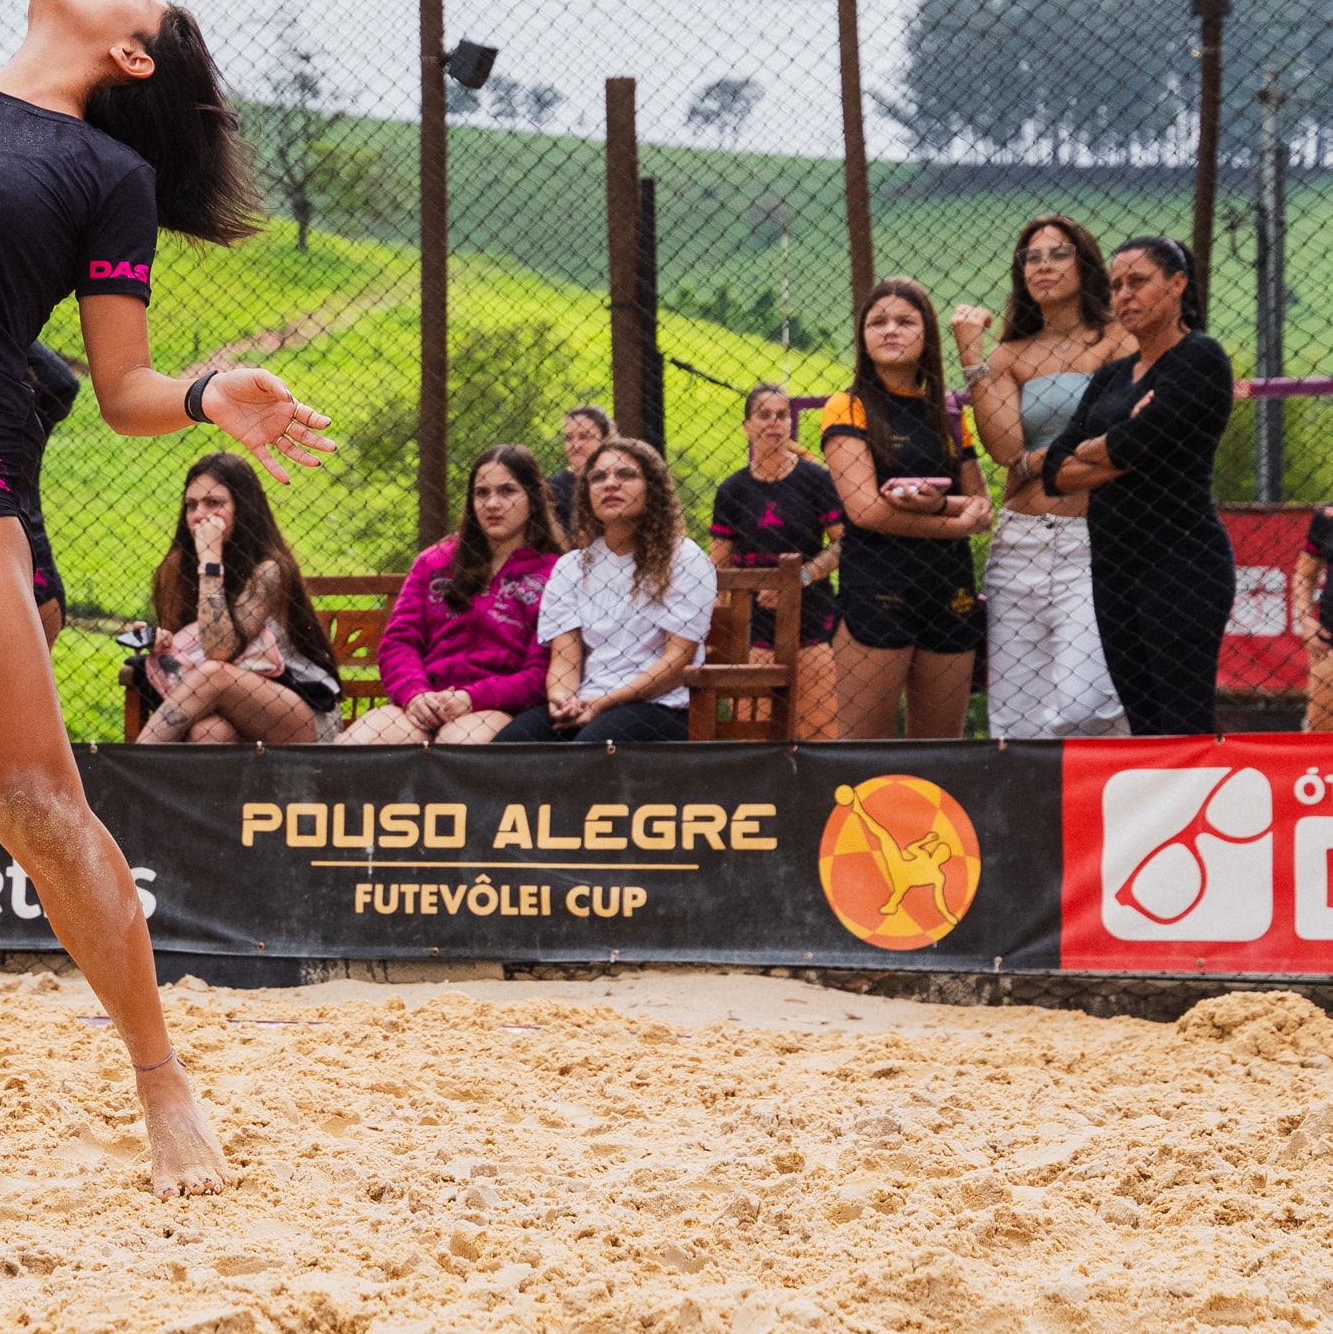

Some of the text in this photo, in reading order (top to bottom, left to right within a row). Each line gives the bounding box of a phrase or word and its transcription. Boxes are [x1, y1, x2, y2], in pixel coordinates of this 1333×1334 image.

[241, 802, 778, 850] POUSO ALEGRE
[354, 873, 648, 918] FUTEVÔLEI CUP
